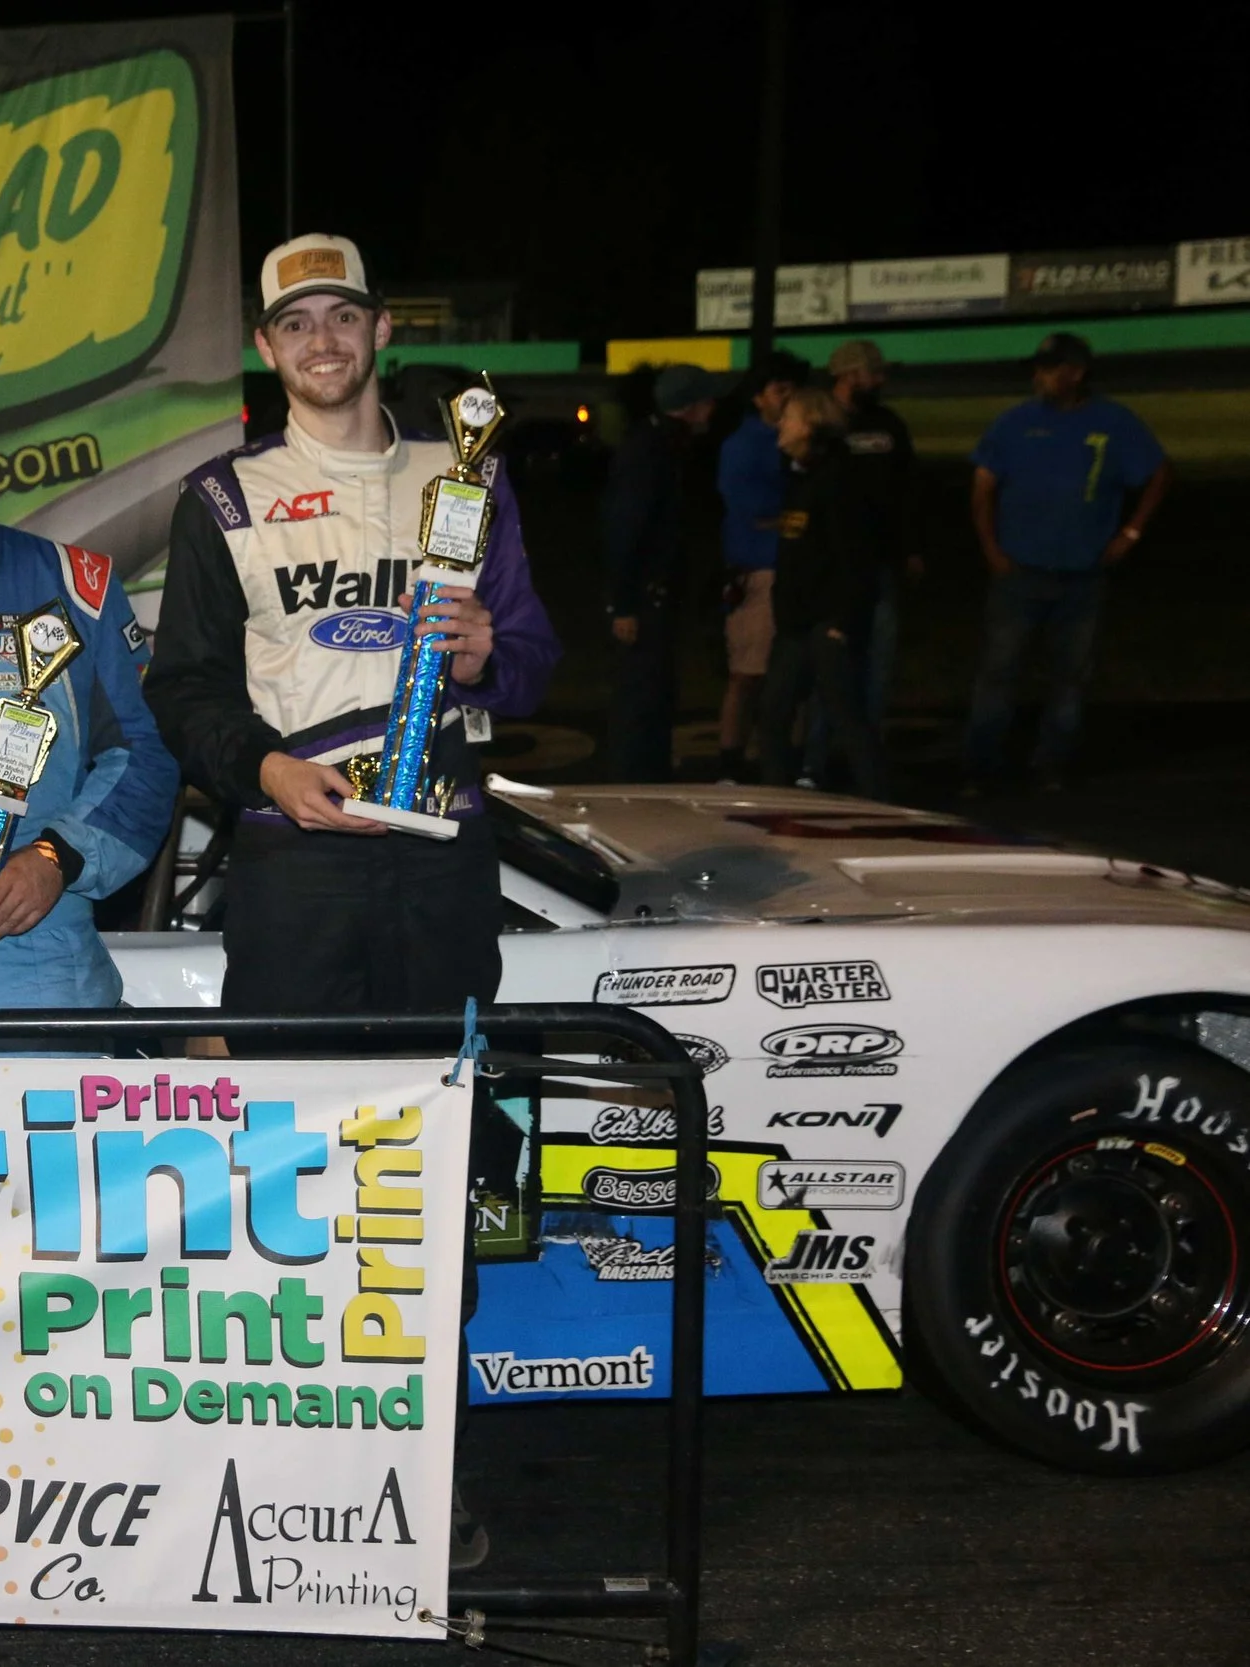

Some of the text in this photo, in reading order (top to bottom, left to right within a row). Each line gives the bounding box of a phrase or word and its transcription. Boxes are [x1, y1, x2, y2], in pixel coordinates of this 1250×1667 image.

[204, 476, 241, 524] sparco
[264, 490, 335, 521] ACT
[430, 544, 473, 560] 2nd Place
[331, 616, 395, 645] Ford
[2, 770, 26, 784] Place
[602, 972, 724, 991] THUNDER ROAD
[761, 964, 876, 994] QUARTER
[781, 981, 883, 1004] MASTER
[781, 1033, 887, 1057] DRP
[768, 1063, 897, 1078] Performance Products
[80, 1073, 242, 1123] Print
[1118, 1073, 1250, 1170] Hoos
[593, 1174, 677, 1204] Basse
[789, 1172, 895, 1184] ALLSTAR
[334, 1104, 427, 1365] Print
[771, 1235, 876, 1271] JMS
[598, 1264, 675, 1280] RACECARS
[769, 1272, 873, 1281] JMSCHIP.COM
[19, 1267, 326, 1369] Print
[476, 1350, 650, 1392] Vermont
[24, 1366, 425, 1432] on Demand
[192, 1457, 418, 1605] AccurA
[28, 1552, 106, 1604] Co.
[263, 1555, 419, 1623] Printing
